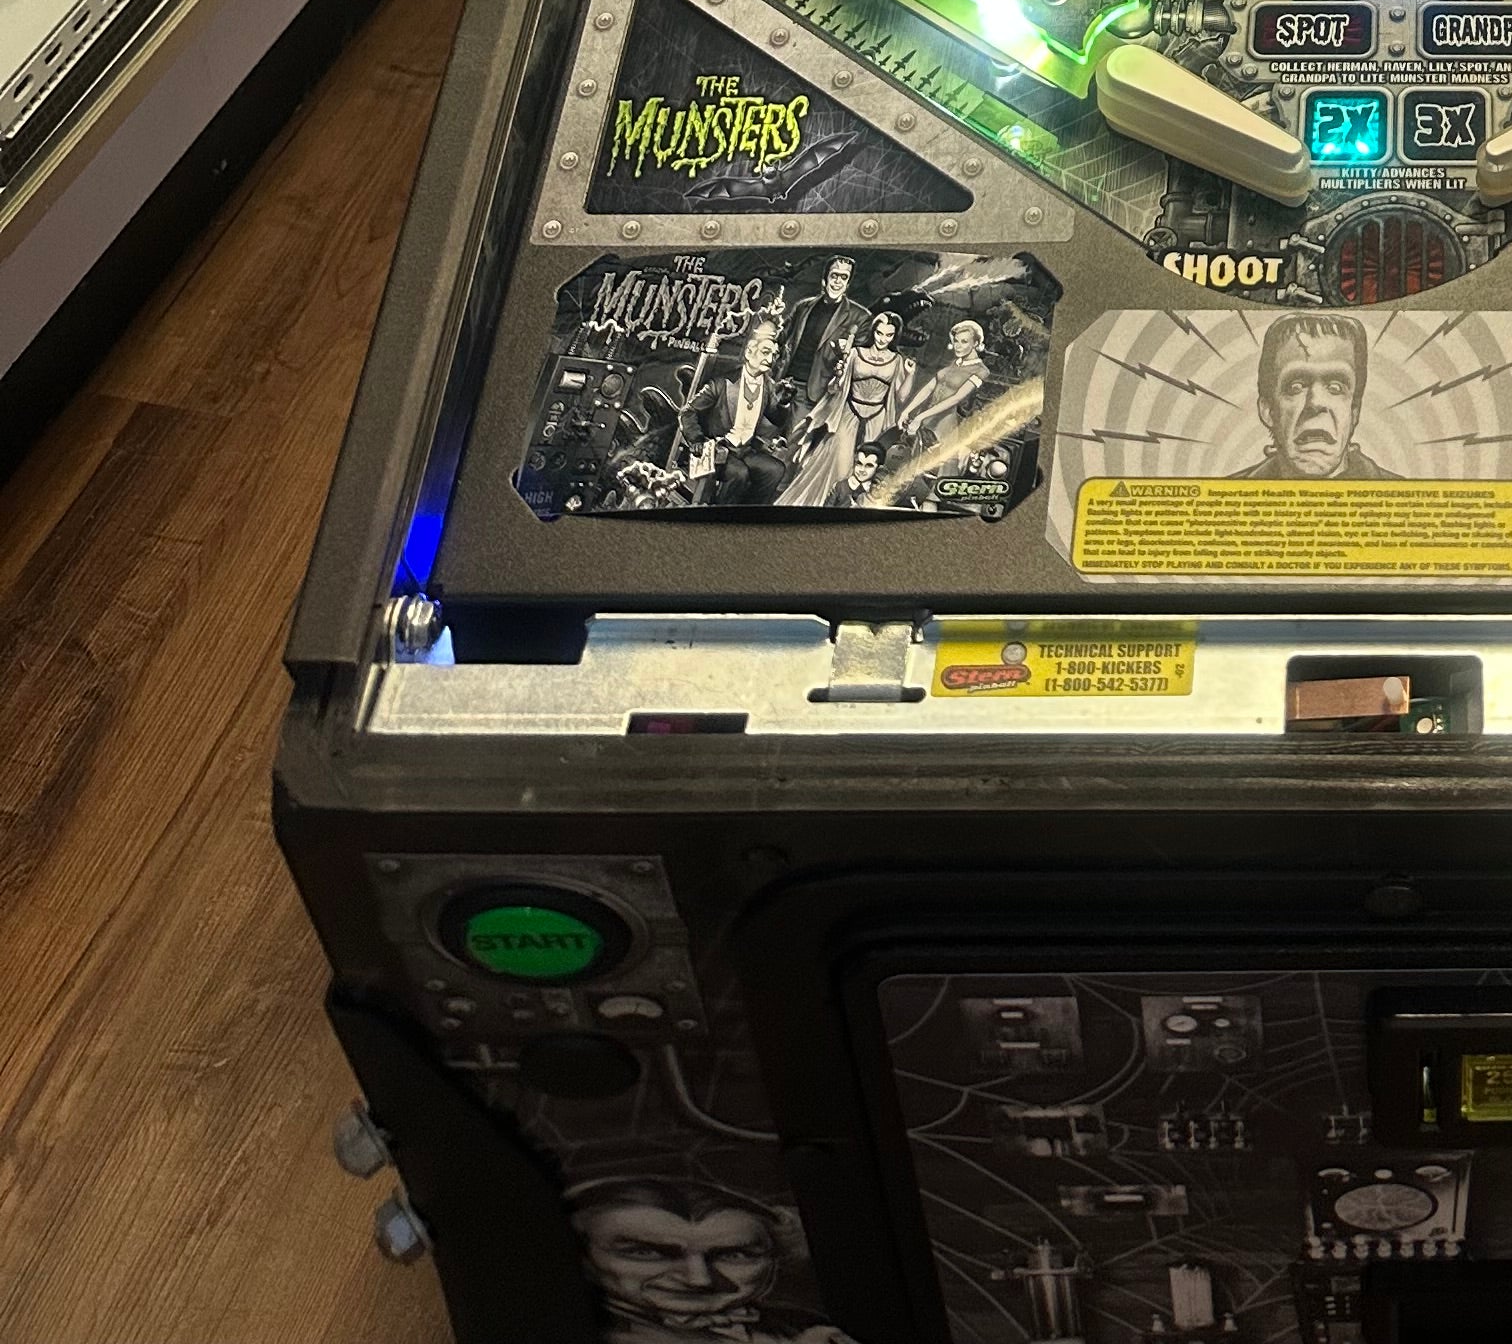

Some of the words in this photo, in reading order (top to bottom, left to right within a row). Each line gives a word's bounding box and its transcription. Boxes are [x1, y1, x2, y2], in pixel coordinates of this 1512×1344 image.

[1276, 13, 1350, 48] SPOT
[1270, 62, 1323, 72] COLLECT
[1327, 62, 1380, 72] HERMAN,
[1383, 63, 1426, 73] RAVEN,
[1428, 63, 1456, 73] LILY,
[1459, 63, 1492, 73] SPOT,
[696, 75, 741, 97] THE
[1281, 74, 1337, 84] GRANDPA
[1341, 74, 1356, 84] TO
[1360, 74, 1386, 84] LITE
[1390, 74, 1447, 84] MUNSTER
[1451, 74, 1509, 84] MADNESS
[1316, 101, 1378, 146] 2X
[1413, 102, 1477, 149] 3X
[606, 95, 811, 179] MUNSTERS
[1340, 168, 1378, 178] KITTY
[1381, 168, 1446, 178] ADVANCES
[1319, 179, 1400, 189] MULTIPLIERS
[1404, 179, 1442, 189] WHEN
[1446, 179, 1466, 189] LIT
[673, 255, 706, 274] THE
[590, 270, 763, 351] MUNSTERS
[667, 336, 707, 353] PINBALL
[943, 482, 1004, 496] Stern
[1130, 485, 1201, 498] WARNING
[1207, 490, 1259, 499] Important
[1262, 490, 1296, 498] Health
[1298, 490, 1345, 500] Warning:
[1346, 490, 1440, 499] PHOTOSENSITIVE
[1442, 490, 1496, 499] SEIZURES
[1142, 560, 1163, 569] STOP
[1166, 561, 1201, 569] PLAYING
[1205, 561, 1223, 570] AND
[1038, 644, 1114, 658] TECHNICAL
[1117, 643, 1182, 658] SUPPORT
[1055, 660, 1162, 675] 1-800-KICKERS
[948, 668, 1024, 685] Stern
[1044, 677, 1169, 692] (1-800-542-5377)
[470, 932, 588, 952] START
